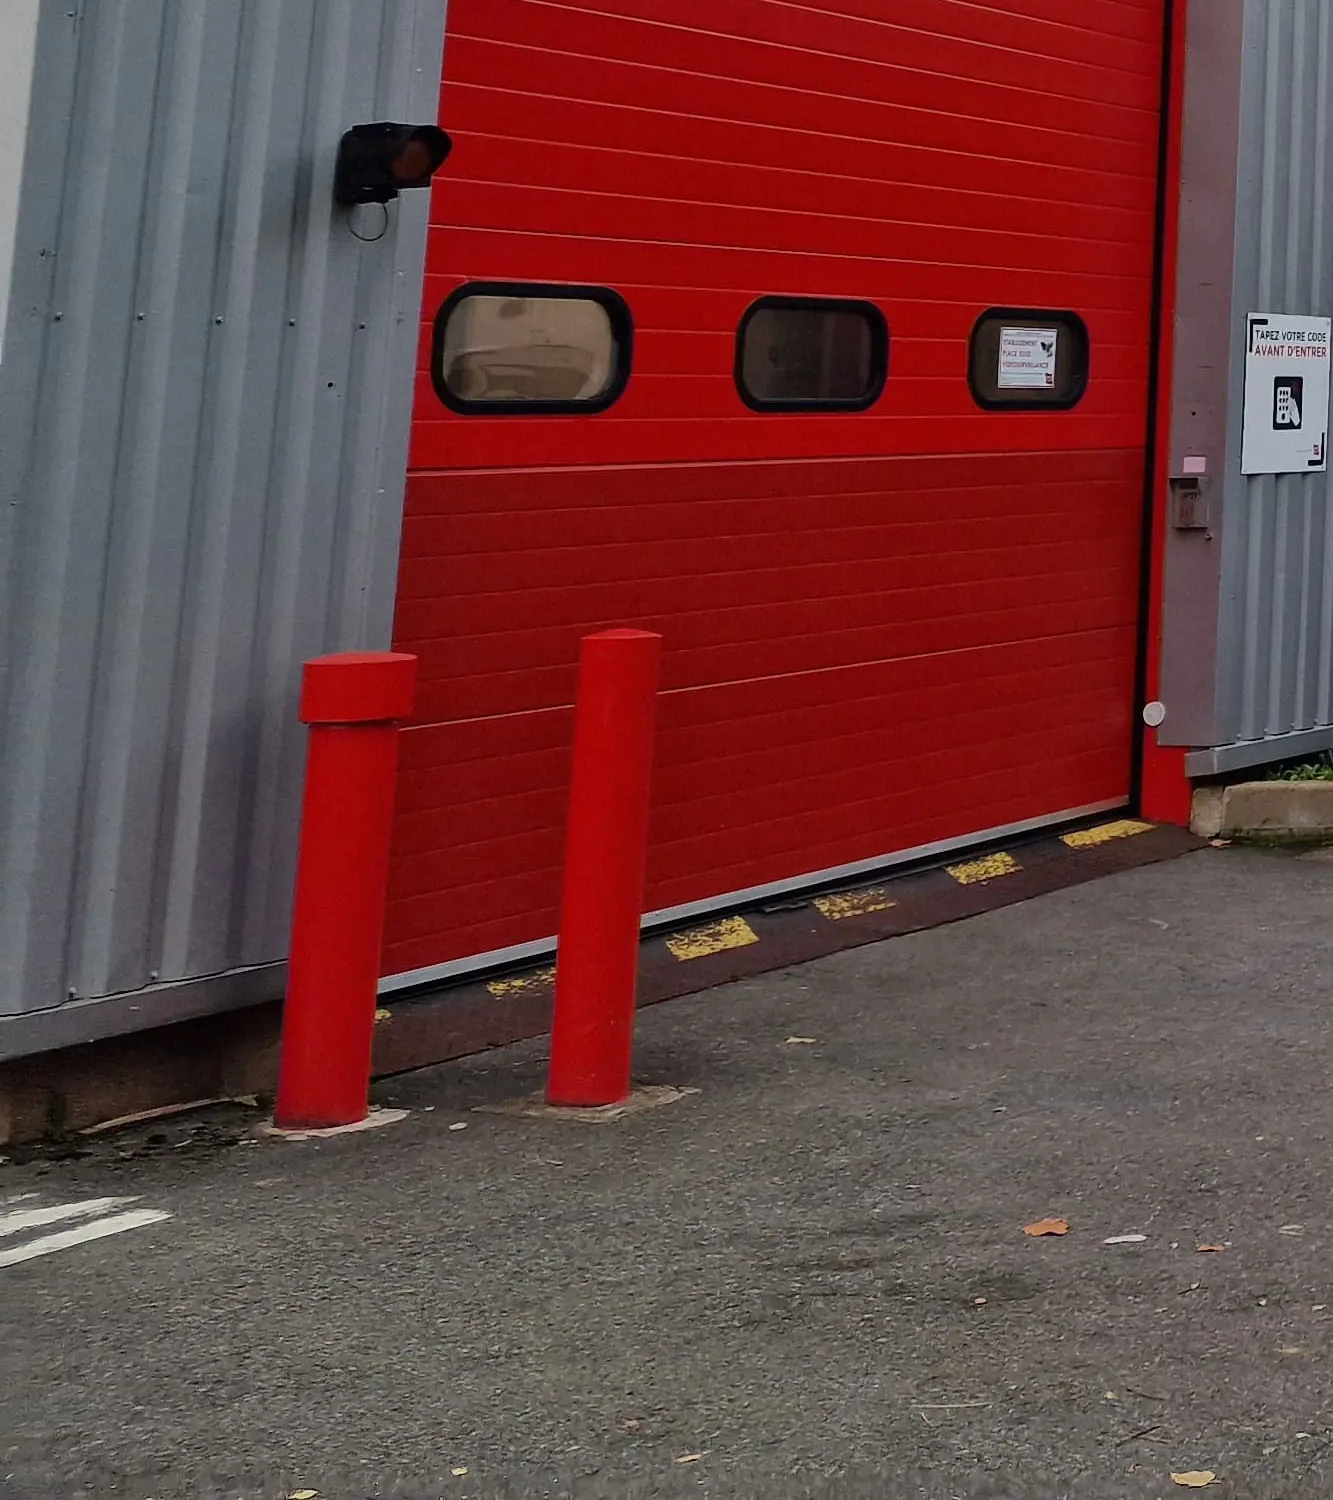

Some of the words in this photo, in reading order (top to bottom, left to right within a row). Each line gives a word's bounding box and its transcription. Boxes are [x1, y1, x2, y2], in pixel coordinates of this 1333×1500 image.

[1256, 329, 1280, 341] TAPEZ
[1282, 331, 1306, 342] VOTRE
[1308, 332, 1327, 343] CODE
[1255, 344, 1285, 357] AVANT
[1287, 345, 1327, 358] D'ENTRER
